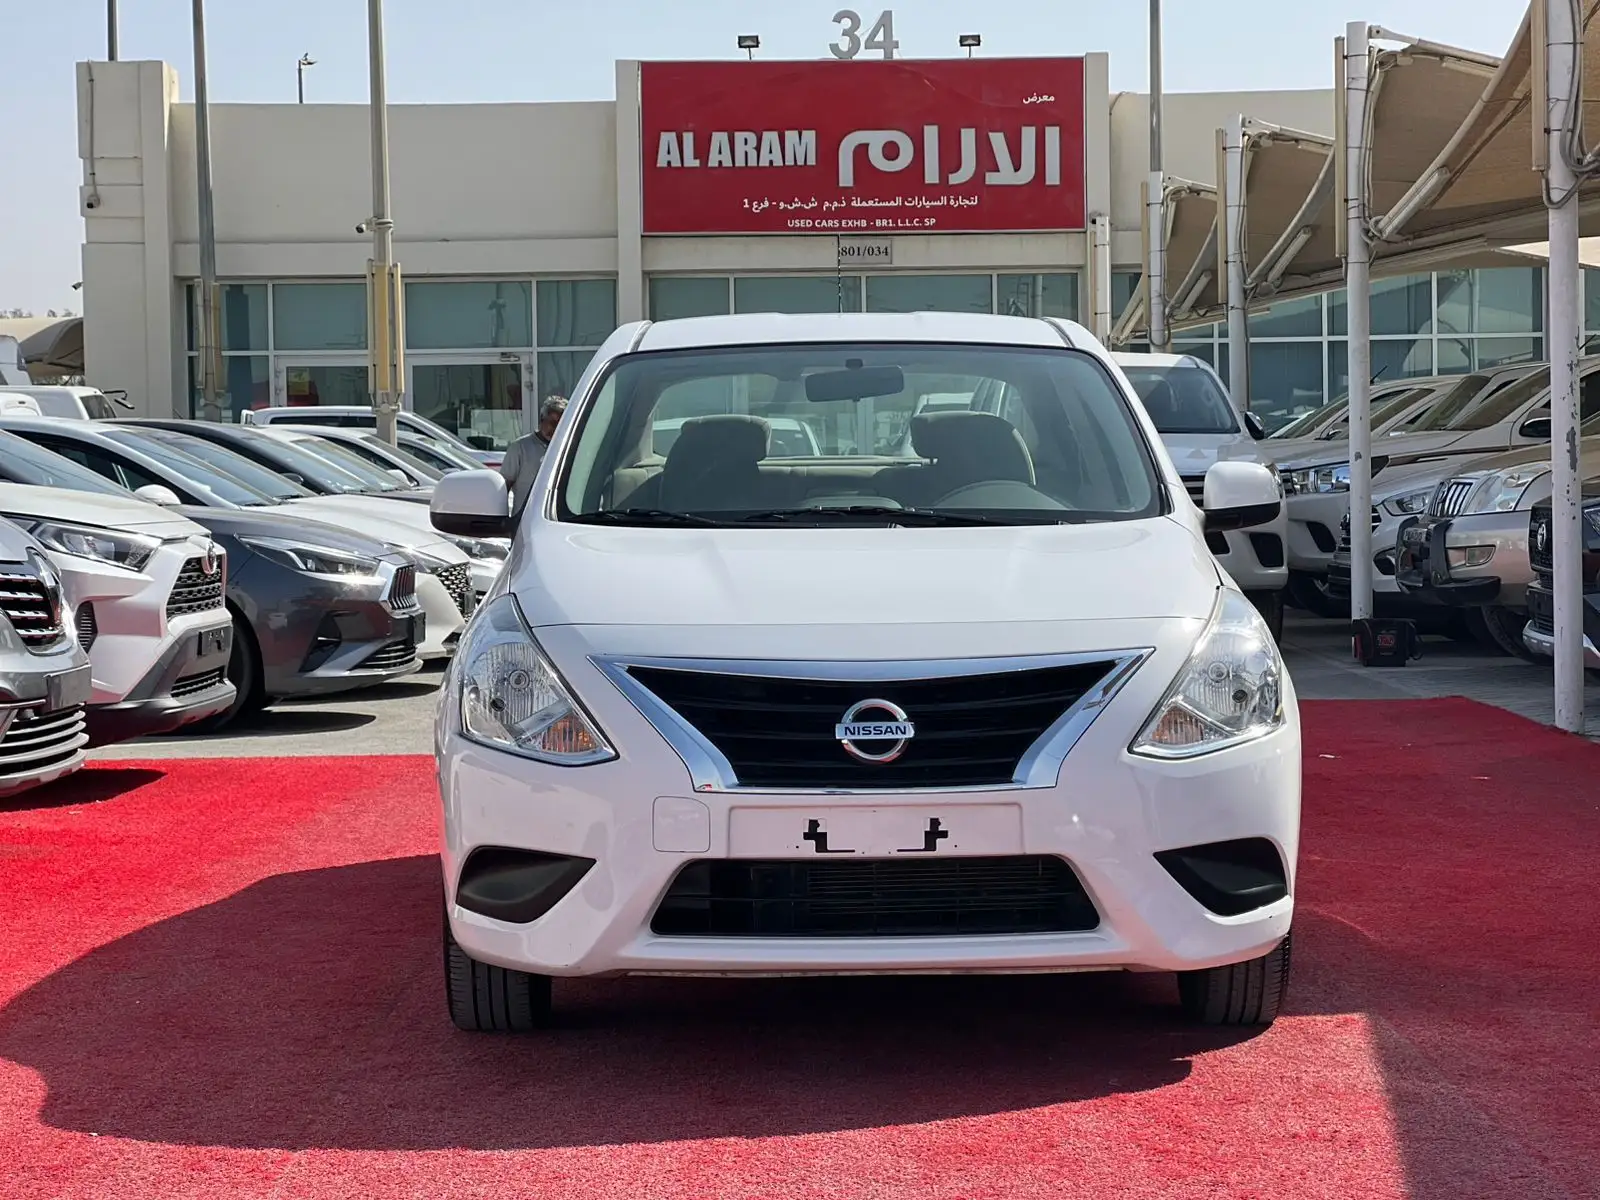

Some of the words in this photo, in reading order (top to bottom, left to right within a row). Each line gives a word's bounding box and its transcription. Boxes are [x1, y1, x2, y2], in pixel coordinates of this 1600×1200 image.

[829, 9, 899, 60] 34
[1022, 92, 1055, 104] معرض
[656, 131, 701, 168] AL
[707, 130, 817, 168] ARAM
[751, 197, 770, 213] فرع
[850, 196, 902, 208] المستعملة
[904, 195, 947, 208] السيارات
[949, 195, 979, 208] لتجارة
[787, 219, 813, 228] USED
[814, 219, 840, 228] CARS
[841, 219, 868, 228] EXHB
[897, 218, 922, 227] L.L.C.
[924, 218, 936, 226] SP
[840, 245, 889, 257] 801/034
[844, 725, 907, 736] NISSAN
